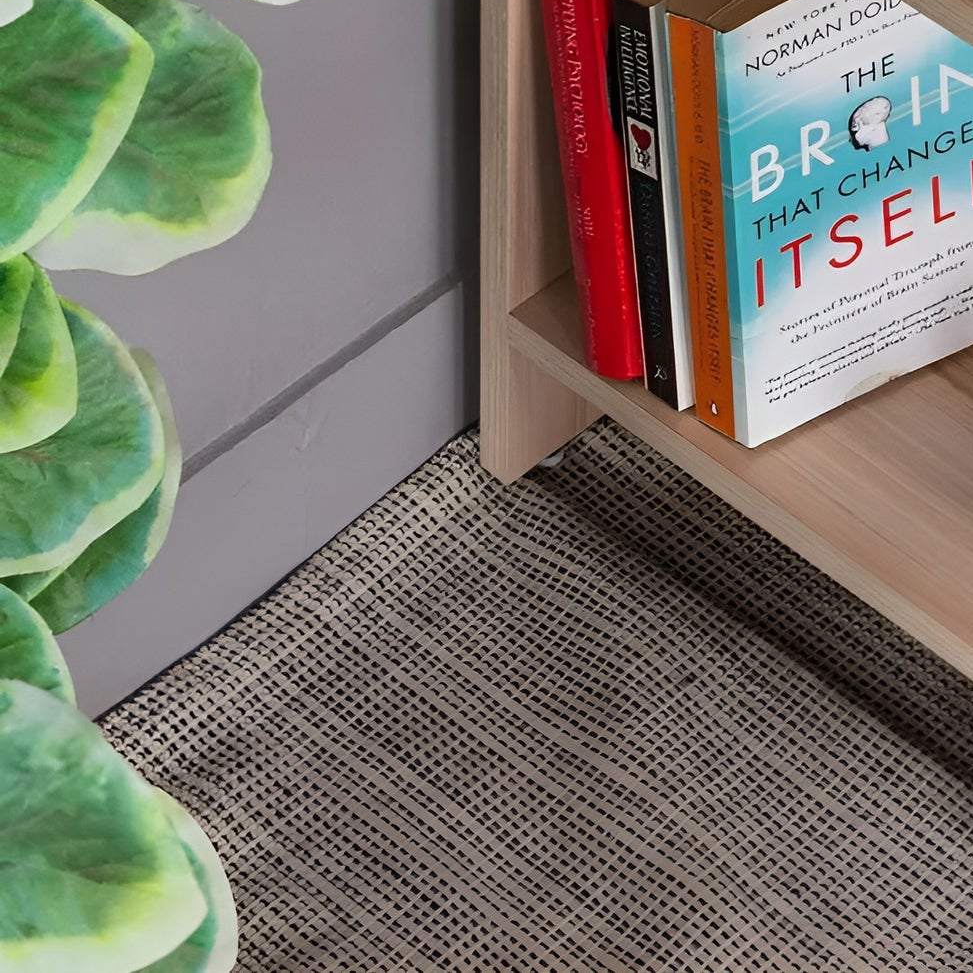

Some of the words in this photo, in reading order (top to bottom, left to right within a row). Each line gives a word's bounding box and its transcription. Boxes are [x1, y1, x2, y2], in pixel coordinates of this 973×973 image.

[619, 24, 639, 115] INTELLIGENCE
[633, 28, 654, 120] EMOTIONAL
[745, 16, 842, 78] NORMAN
[840, 53, 896, 94] THE
[752, 187, 825, 241] THAT
